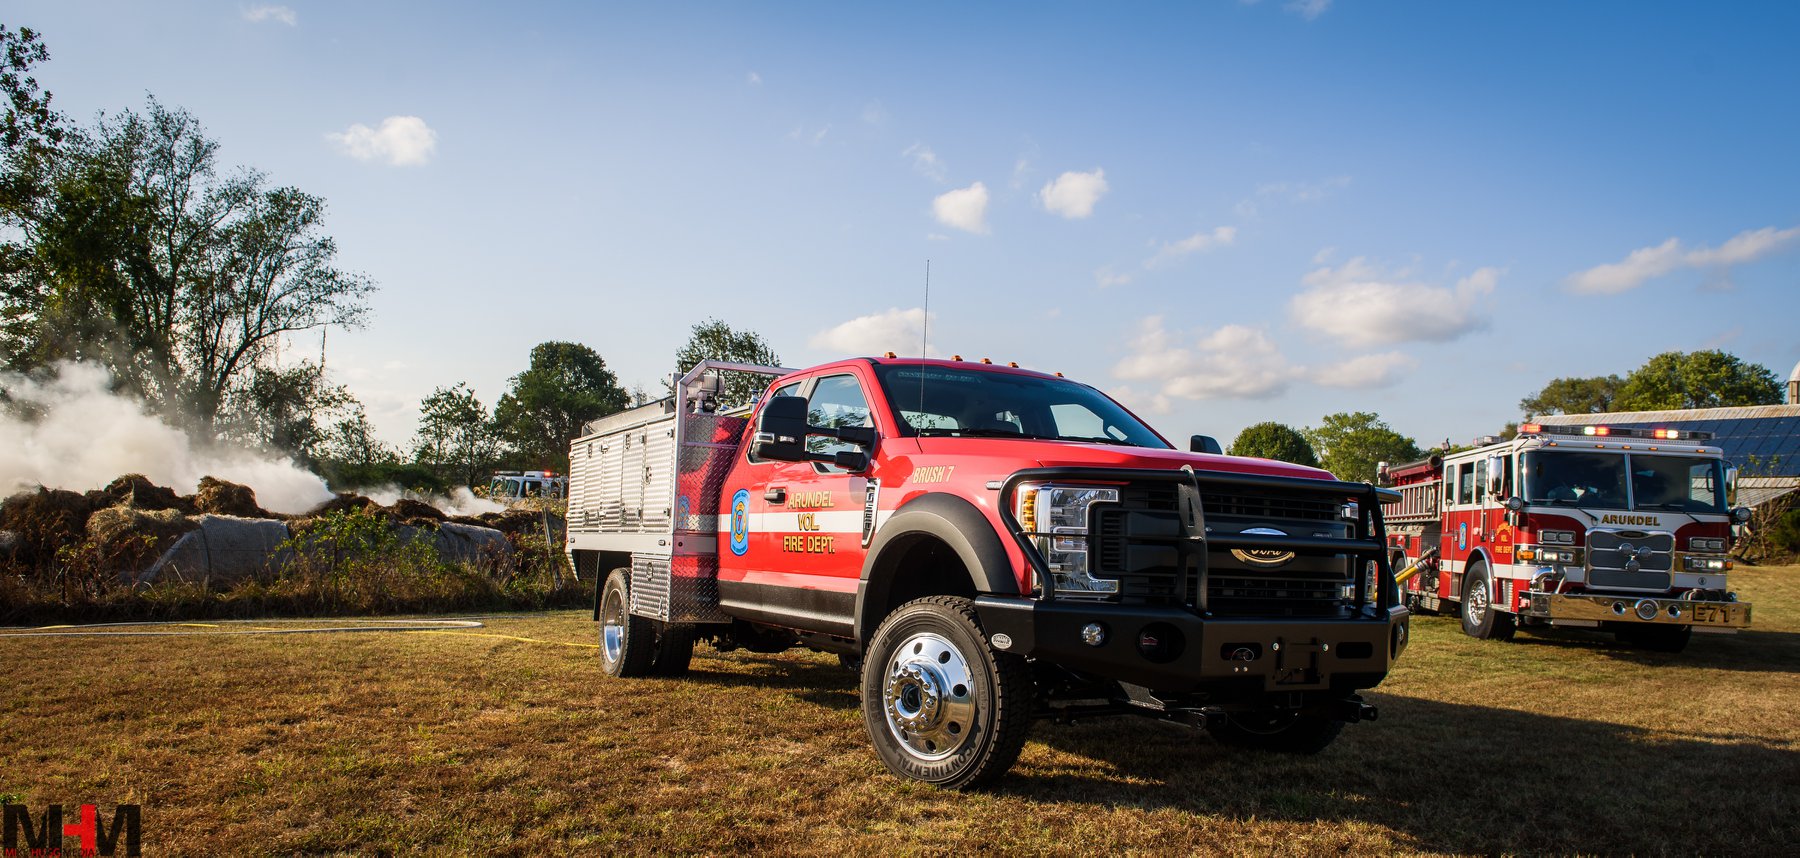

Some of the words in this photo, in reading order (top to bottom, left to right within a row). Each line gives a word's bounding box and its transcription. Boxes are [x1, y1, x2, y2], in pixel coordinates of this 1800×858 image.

[912, 466, 945, 484] BRUSH
[946, 465, 955, 482] 7
[787, 491, 835, 509] ARUNDEL
[1601, 514, 1661, 527] ARUNDEL
[783, 536, 804, 552] FIRE
[807, 536, 836, 554] DEPT.
[1692, 603, 1730, 623] E71
[896, 748, 974, 779] CONTINENTAL
